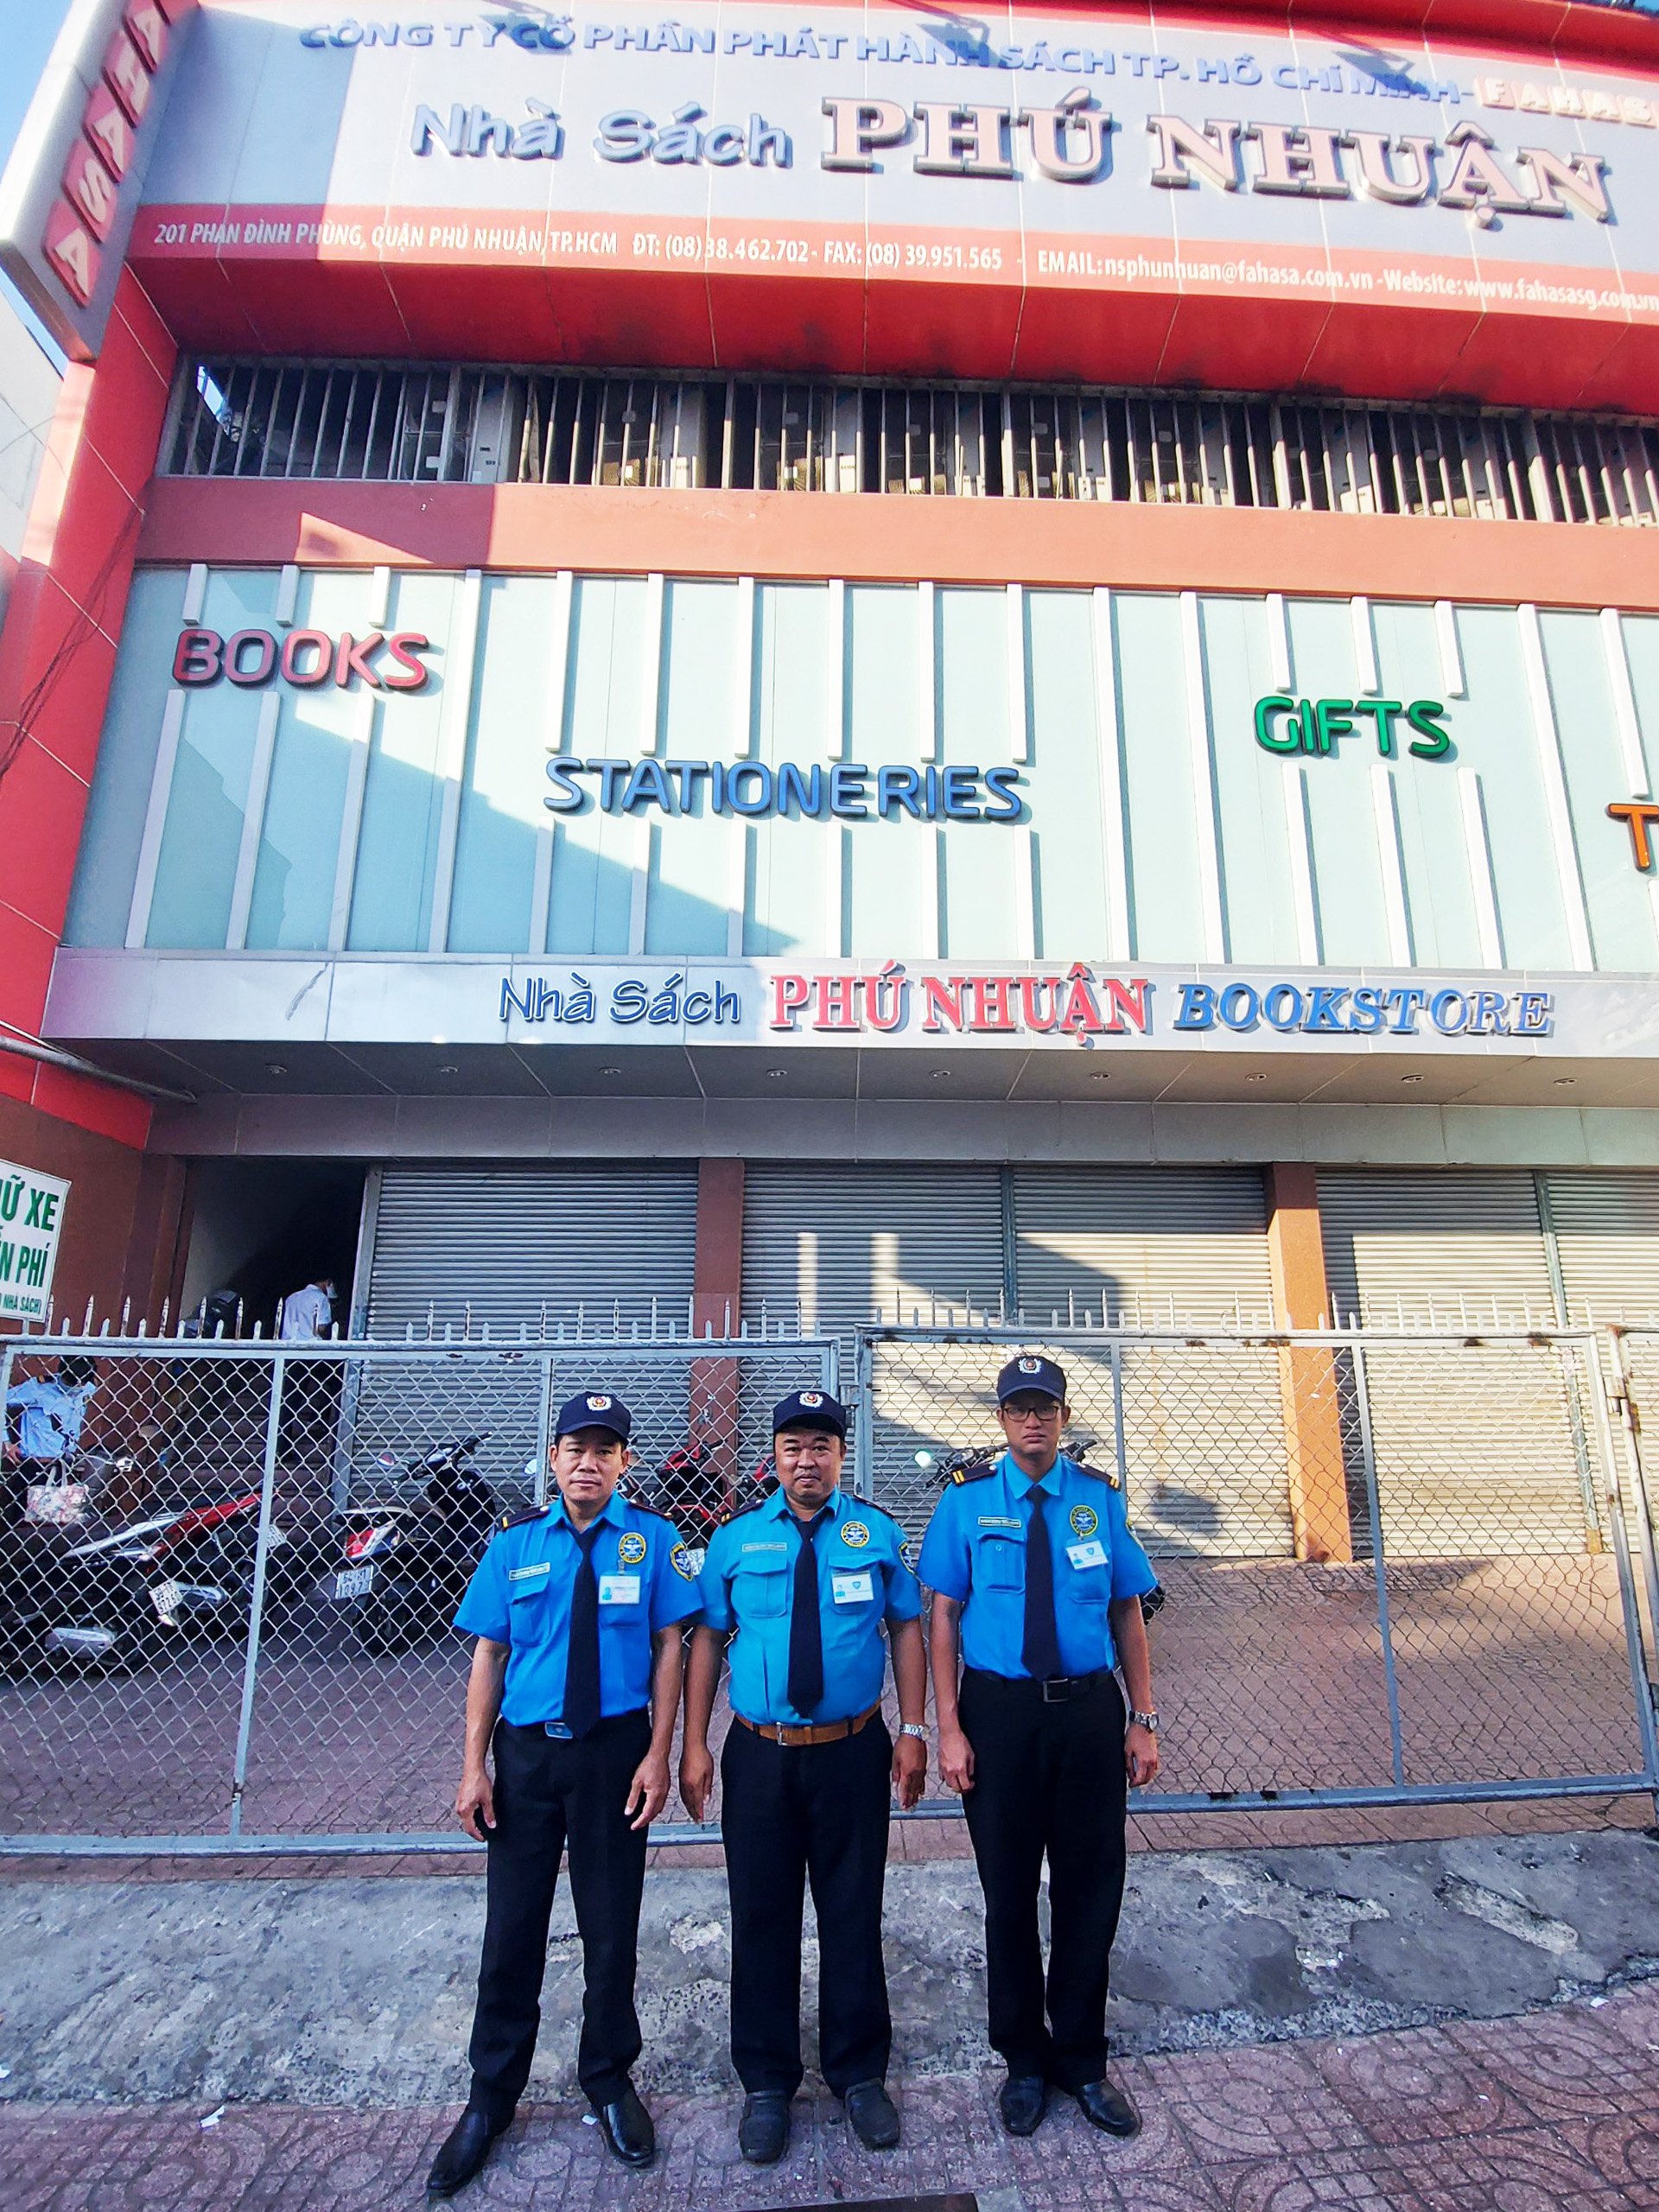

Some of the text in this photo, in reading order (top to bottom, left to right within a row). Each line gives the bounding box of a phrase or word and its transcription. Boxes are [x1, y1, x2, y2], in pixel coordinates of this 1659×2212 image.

[299, 17, 435, 48] CÔNG
[443, 23, 506, 48] TY
[509, 16, 575, 50] CỔ
[583, 19, 716, 53] PHẦN
[723, 26, 849, 59] PHÁT
[856, 31, 990, 68] HÀNH
[996, 41, 1116, 74] SÁCH
[1122, 52, 1190, 80] TP.
[1196, 52, 1262, 86] HỒ
[1270, 64, 1344, 92] CHÍ
[410, 86, 1611, 229] Nhà Sách PHÚ NHUẬN
[154, 223, 187, 245] 201
[244, 219, 291, 245] ĐÌNH
[296, 219, 367, 251] PHÙNG,
[372, 222, 423, 252] QUẬN
[429, 224, 468, 249] PHÚ
[550, 230, 618, 254] TP.HCM
[632, 233, 661, 256] ĐT:
[665, 234, 702, 260] (08)
[905, 244, 1002, 270] 39.951.565
[172, 627, 429, 691] BOOKS
[1254, 696, 1451, 759] GIFTS
[543, 756, 1023, 821] STATIONERIES
[499, 960, 1552, 1046] Nhà Sách PHÚ NHUẬN BOOKSTORE
[0, 1174, 60, 1232] Ữ XE
[16, 1242, 50, 1287] PHÍ
